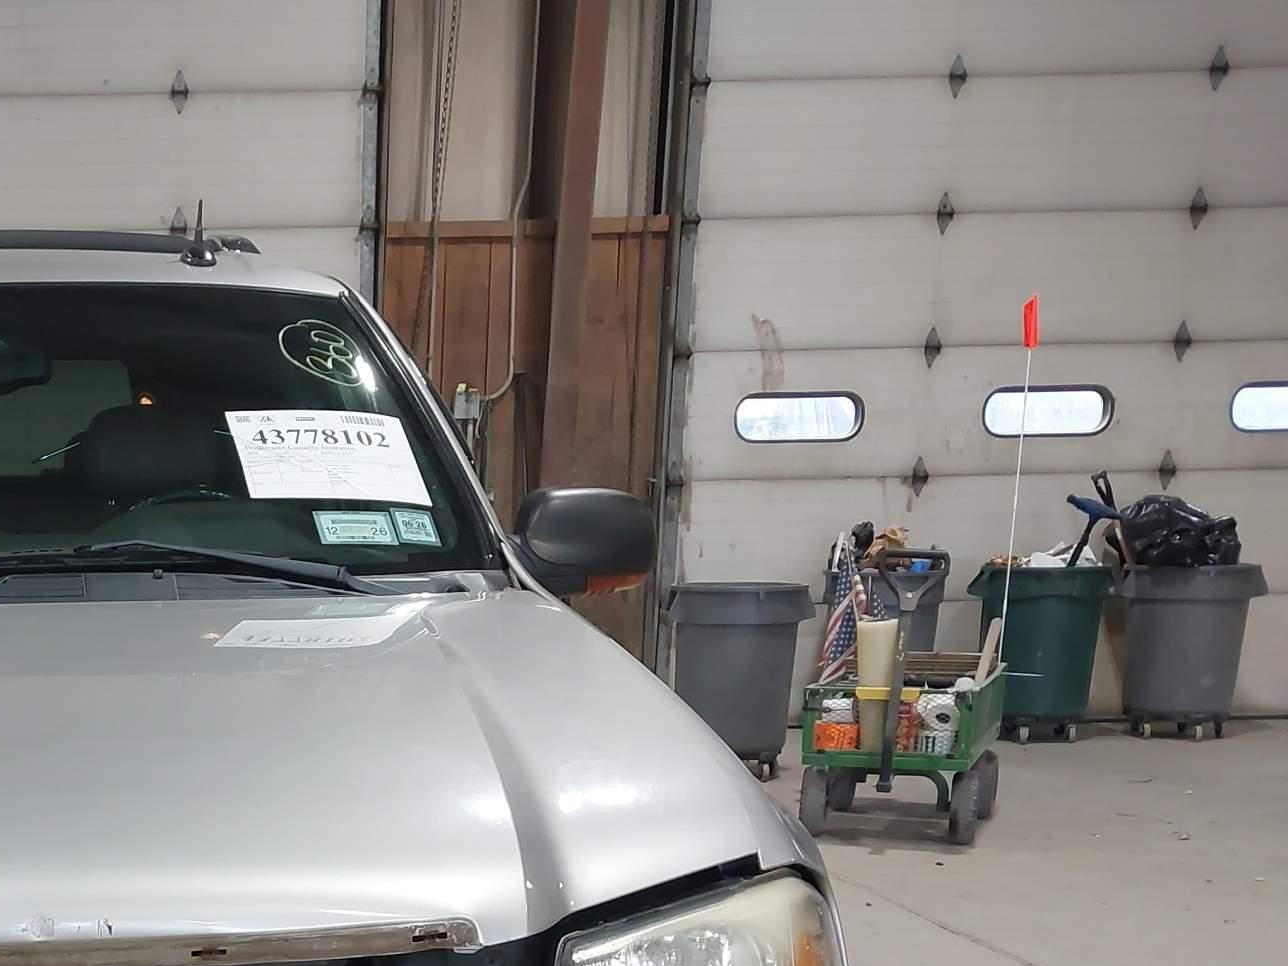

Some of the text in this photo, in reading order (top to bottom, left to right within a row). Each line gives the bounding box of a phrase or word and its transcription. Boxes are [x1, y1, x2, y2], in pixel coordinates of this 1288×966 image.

[252, 428, 391, 448] 43778102
[324, 526, 388, 536] 12 26
